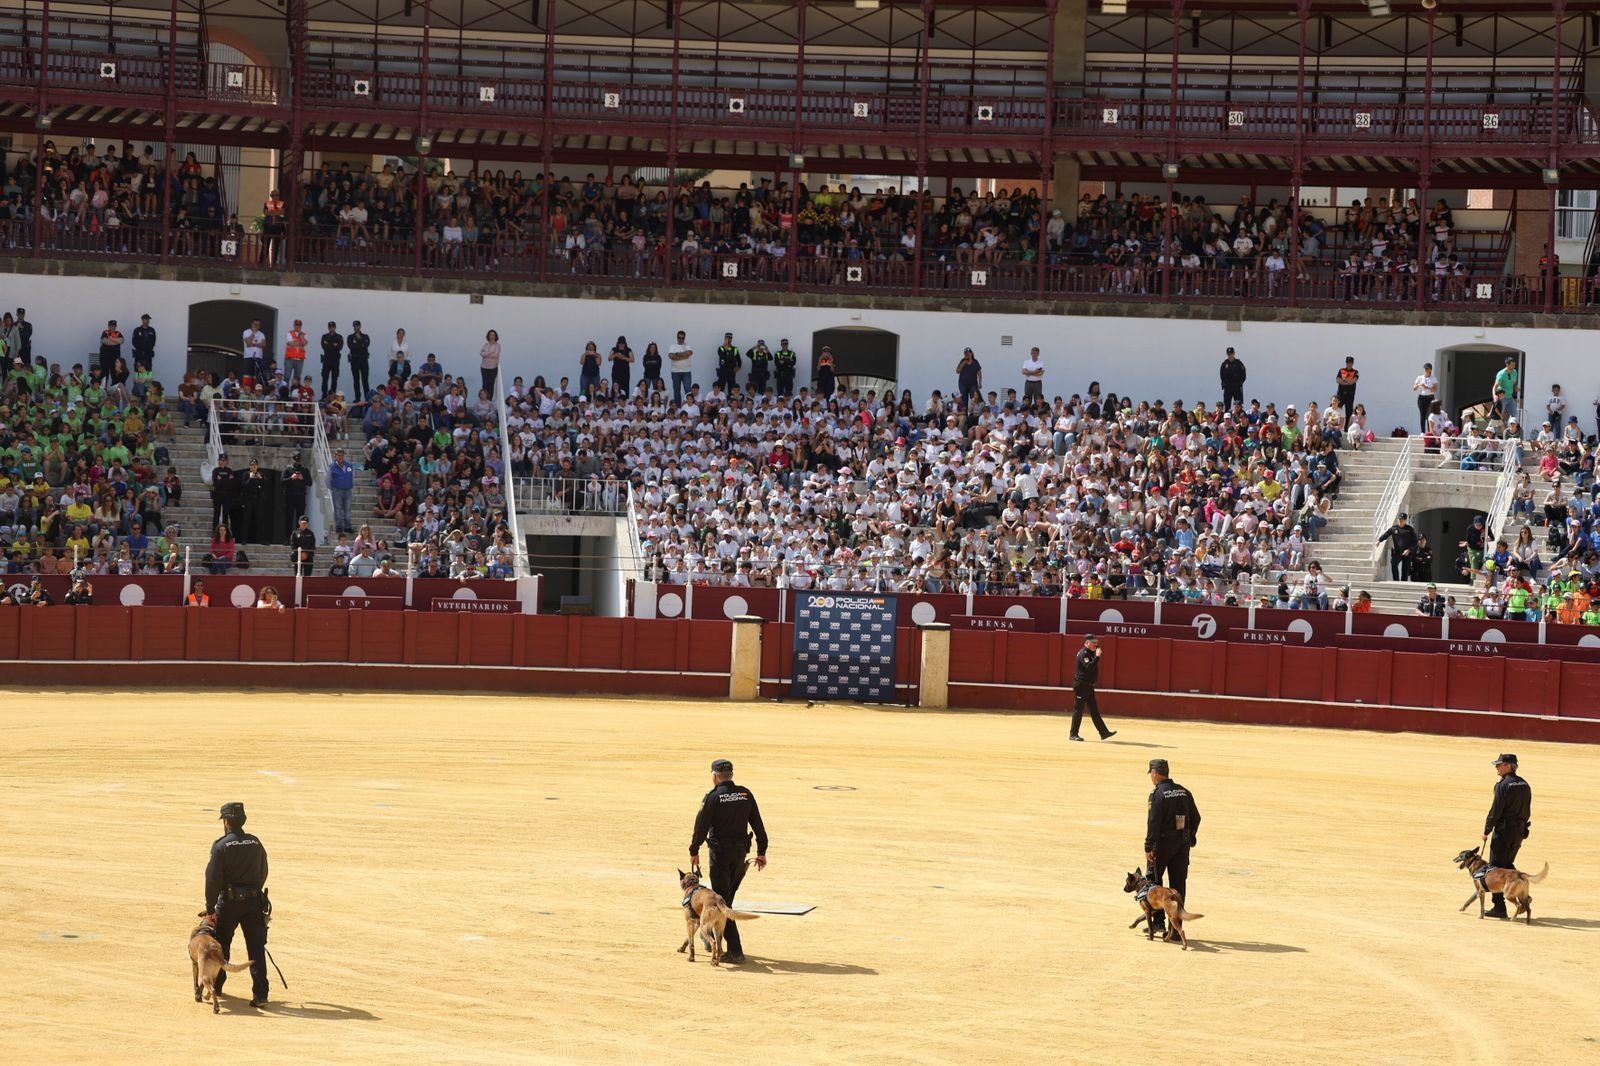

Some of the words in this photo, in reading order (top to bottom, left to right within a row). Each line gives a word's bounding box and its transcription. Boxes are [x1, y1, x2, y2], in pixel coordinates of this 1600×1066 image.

[609, 94, 616, 106] 2
[858, 104, 865, 116] 2
[1107, 110, 1114, 122] 2
[1230, 112, 1243, 124] 30
[1356, 114, 1369, 126] 28
[1484, 115, 1498, 127] 26
[225, 242, 232, 253] 6
[727, 264, 734, 275] 6
[437, 602, 509, 611] VETERINARIOS
[808, 595, 835, 608] 200
[970, 619, 1014, 629] PRENSA
[1106, 625, 1147, 634] MEDICO
[1197, 617, 1211, 635] 7
[1243, 632, 1287, 642] PRENSA
[1449, 643, 1499, 653] PRENSA
